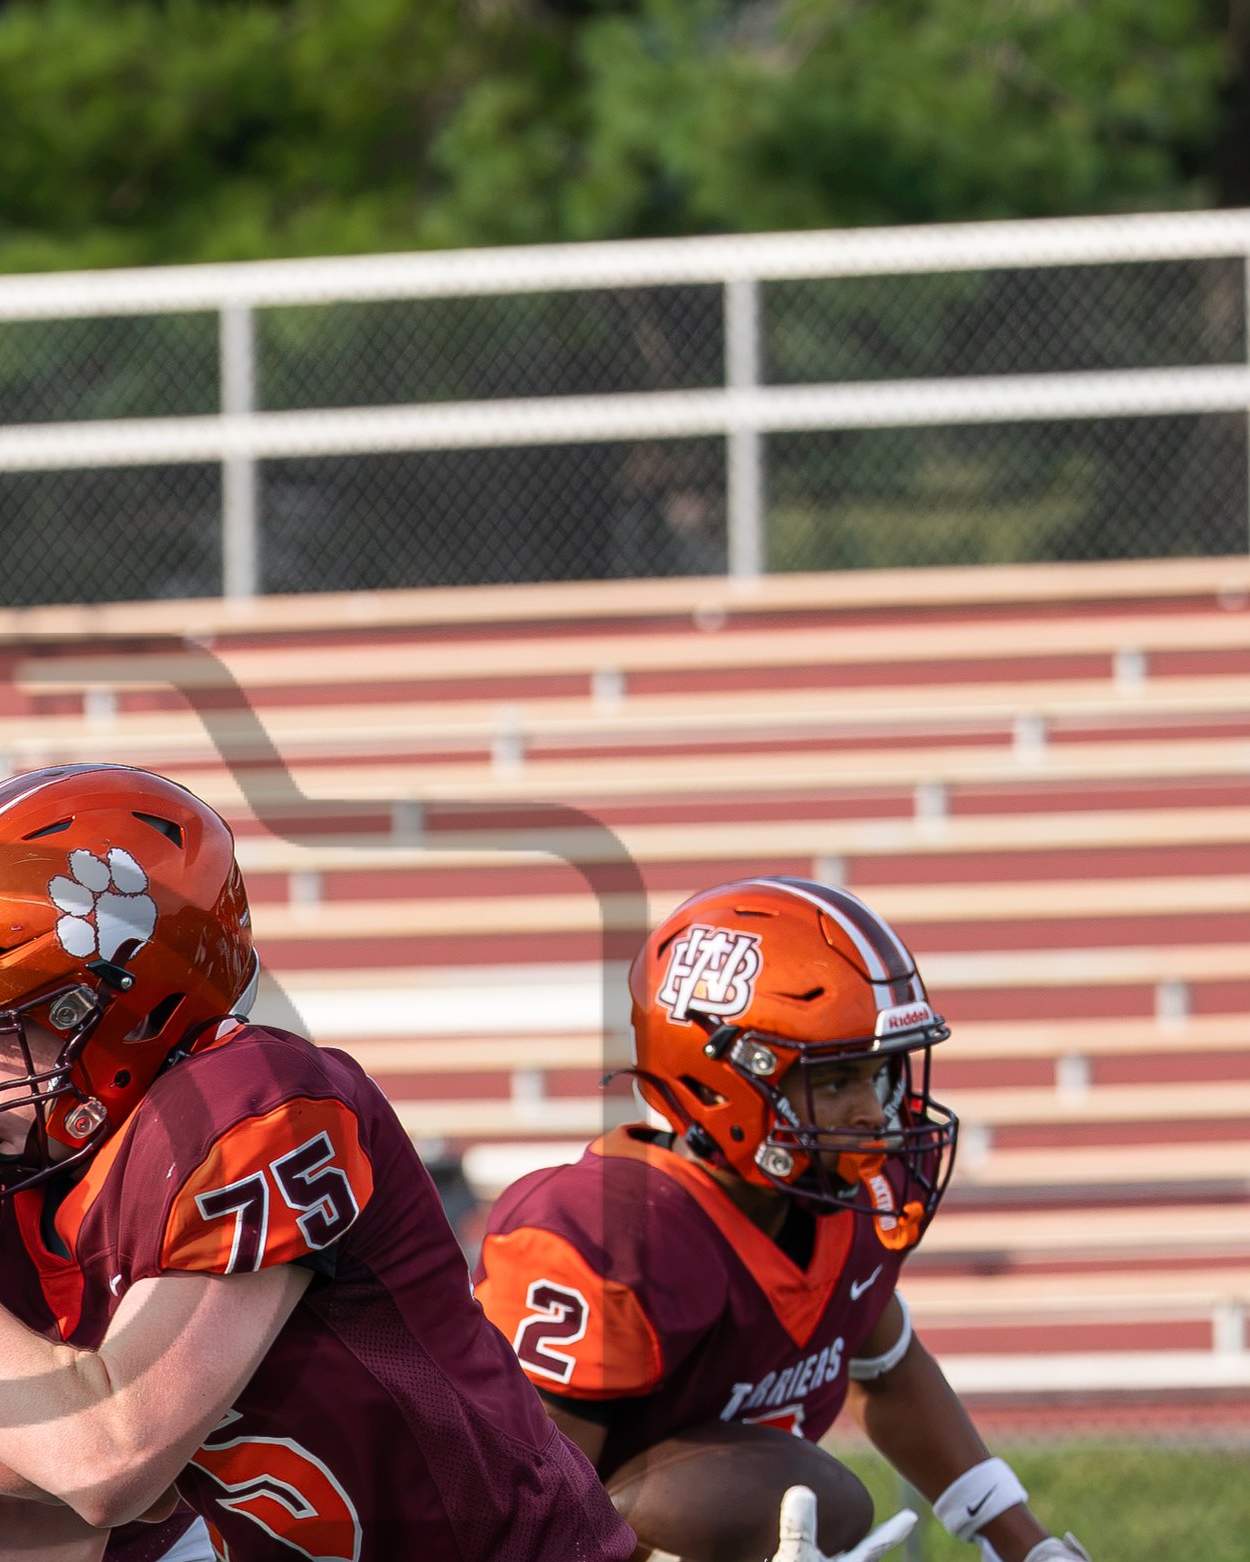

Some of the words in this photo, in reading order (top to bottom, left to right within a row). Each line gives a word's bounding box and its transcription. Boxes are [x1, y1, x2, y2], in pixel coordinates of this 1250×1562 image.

[194, 1130, 360, 1275] 75
[513, 1278, 590, 1385] 2
[719, 1336, 845, 1422] TRRIERS
